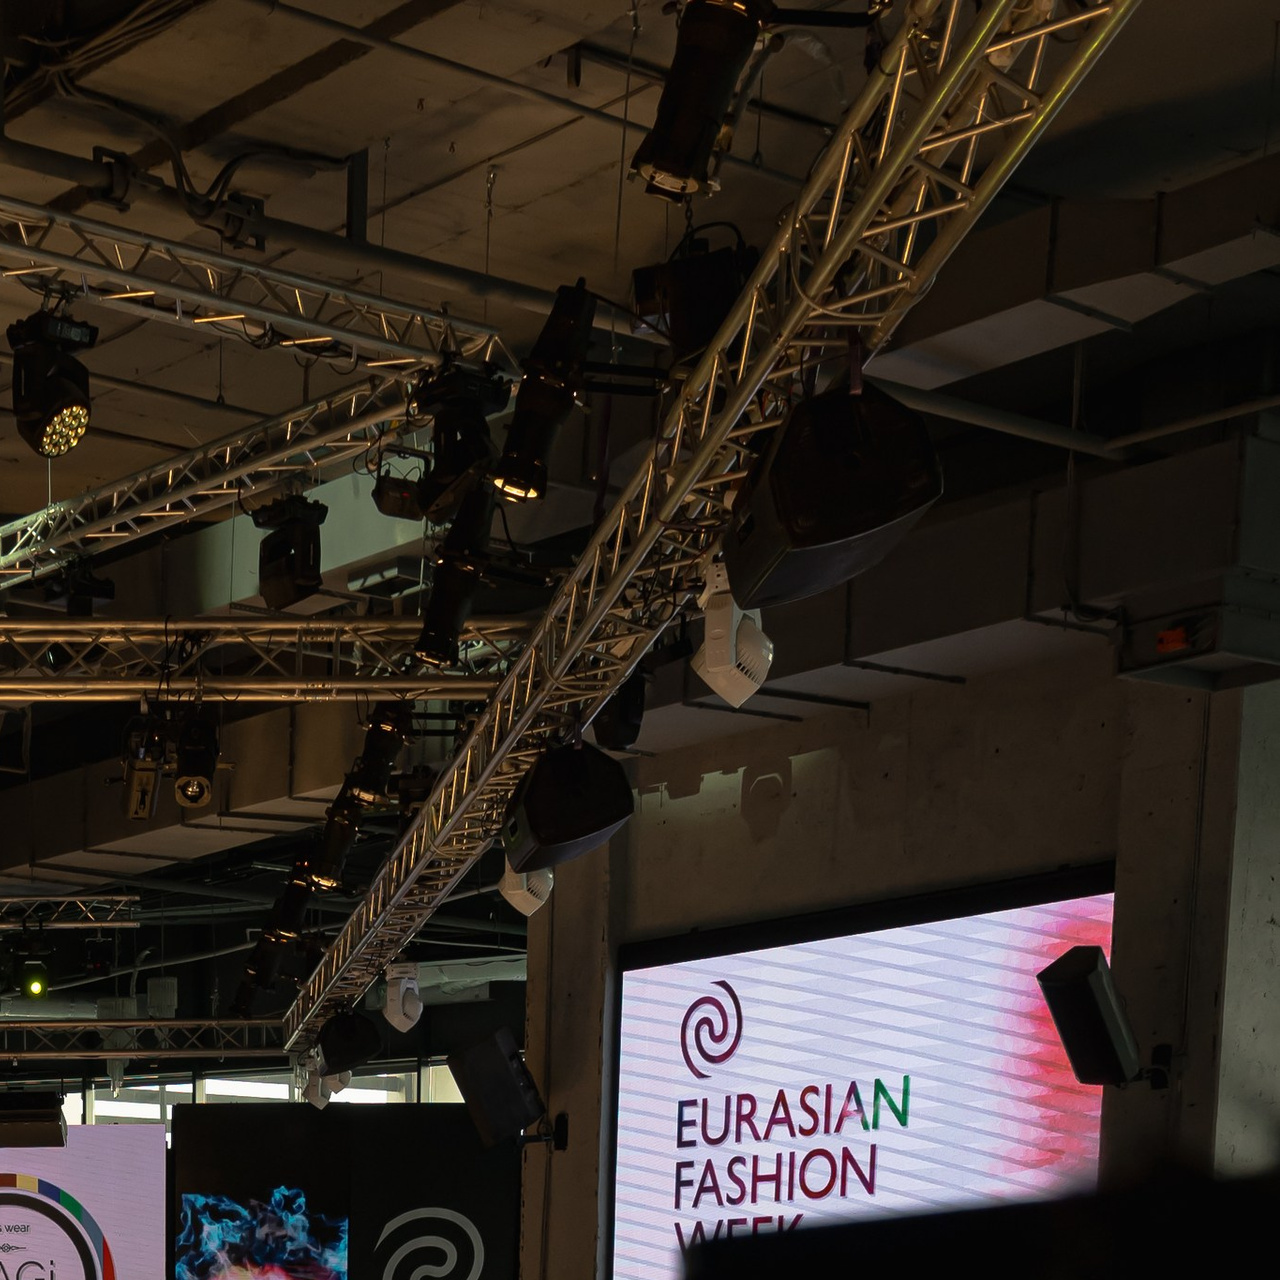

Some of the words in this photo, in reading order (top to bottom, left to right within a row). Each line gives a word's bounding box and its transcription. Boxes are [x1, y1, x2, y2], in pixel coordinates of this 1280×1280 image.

[676, 1074, 911, 1149] EURASIAN
[674, 1143, 877, 1211] FASHION
[4, 1224, 30, 1233] wear
